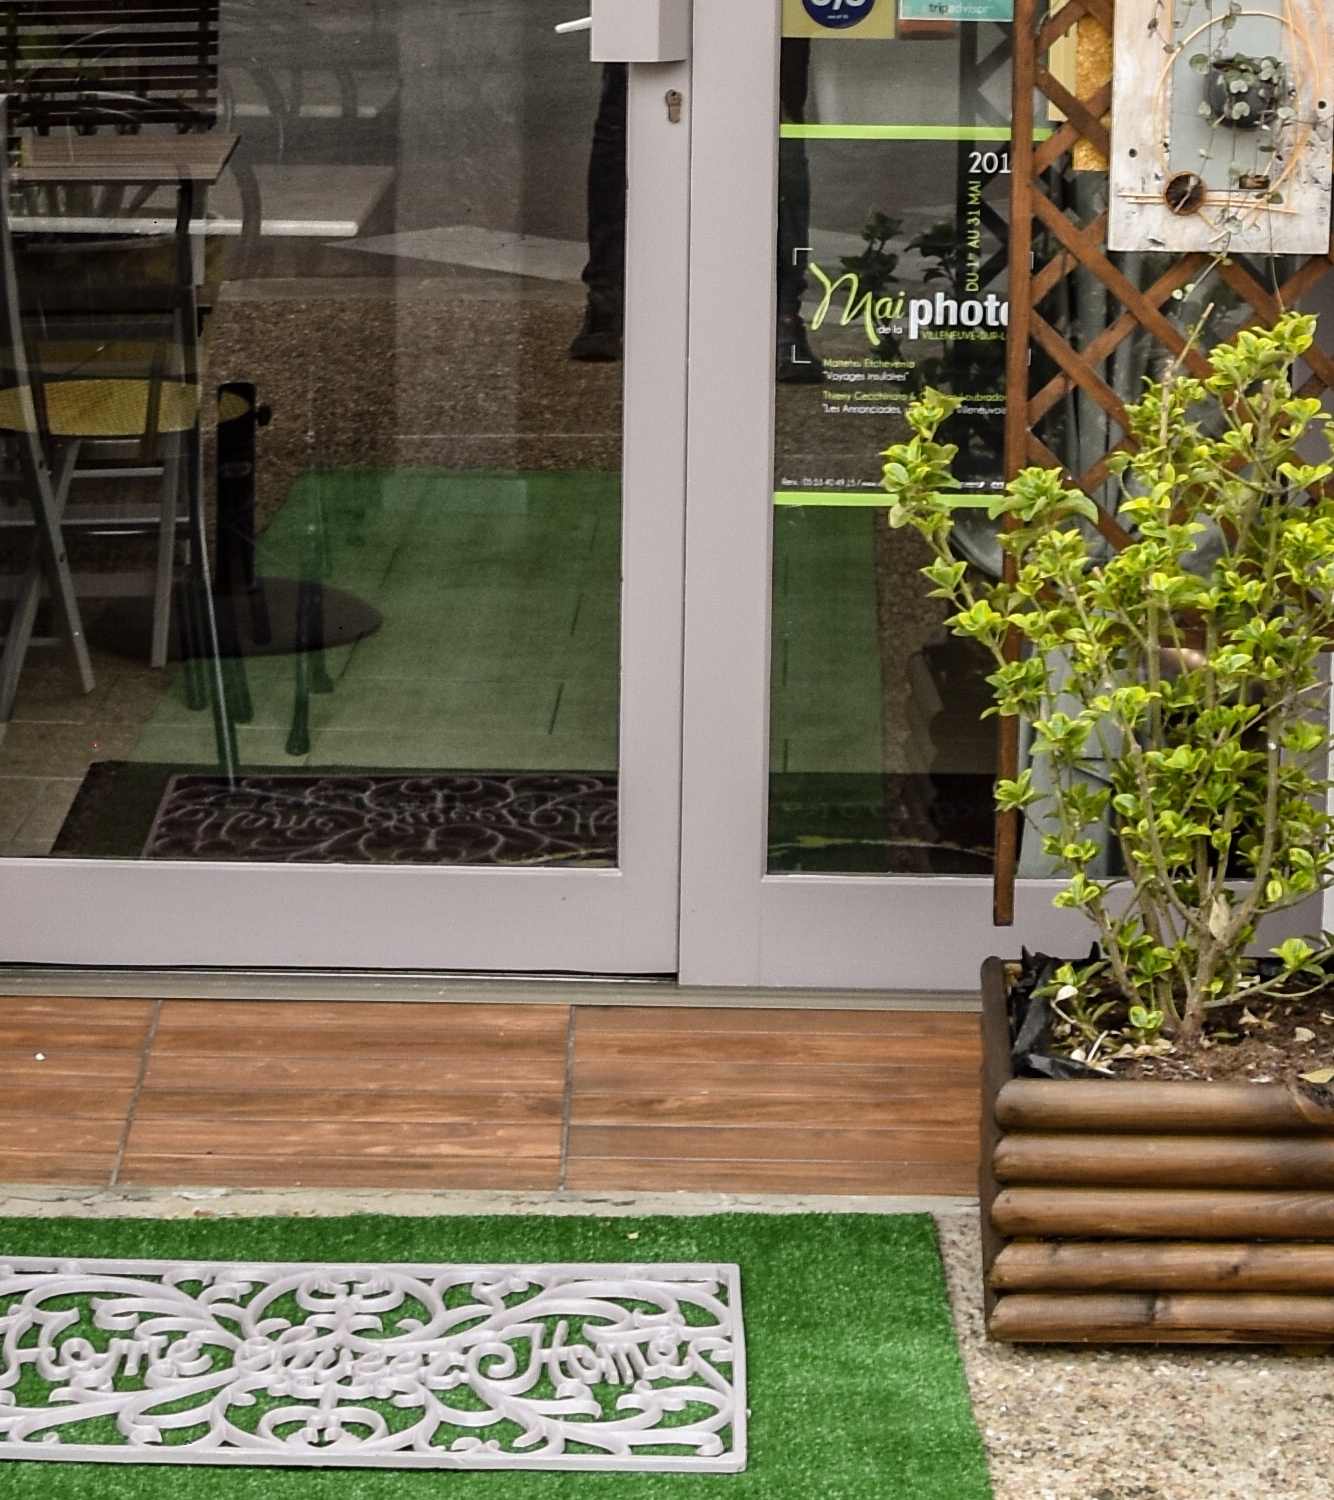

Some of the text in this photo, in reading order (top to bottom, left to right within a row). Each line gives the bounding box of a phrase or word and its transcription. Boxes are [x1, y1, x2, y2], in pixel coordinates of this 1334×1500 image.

[968, 151, 1012, 175] 201
[968, 180, 982, 206] MAI
[967, 210, 981, 226] 31
[967, 228, 981, 249] AU
[965, 271, 979, 292] DU
[809, 262, 906, 346] Mai
[877, 324, 903, 335] de la
[922, 330, 1008, 341] VILLENEUVE-SUR-L
